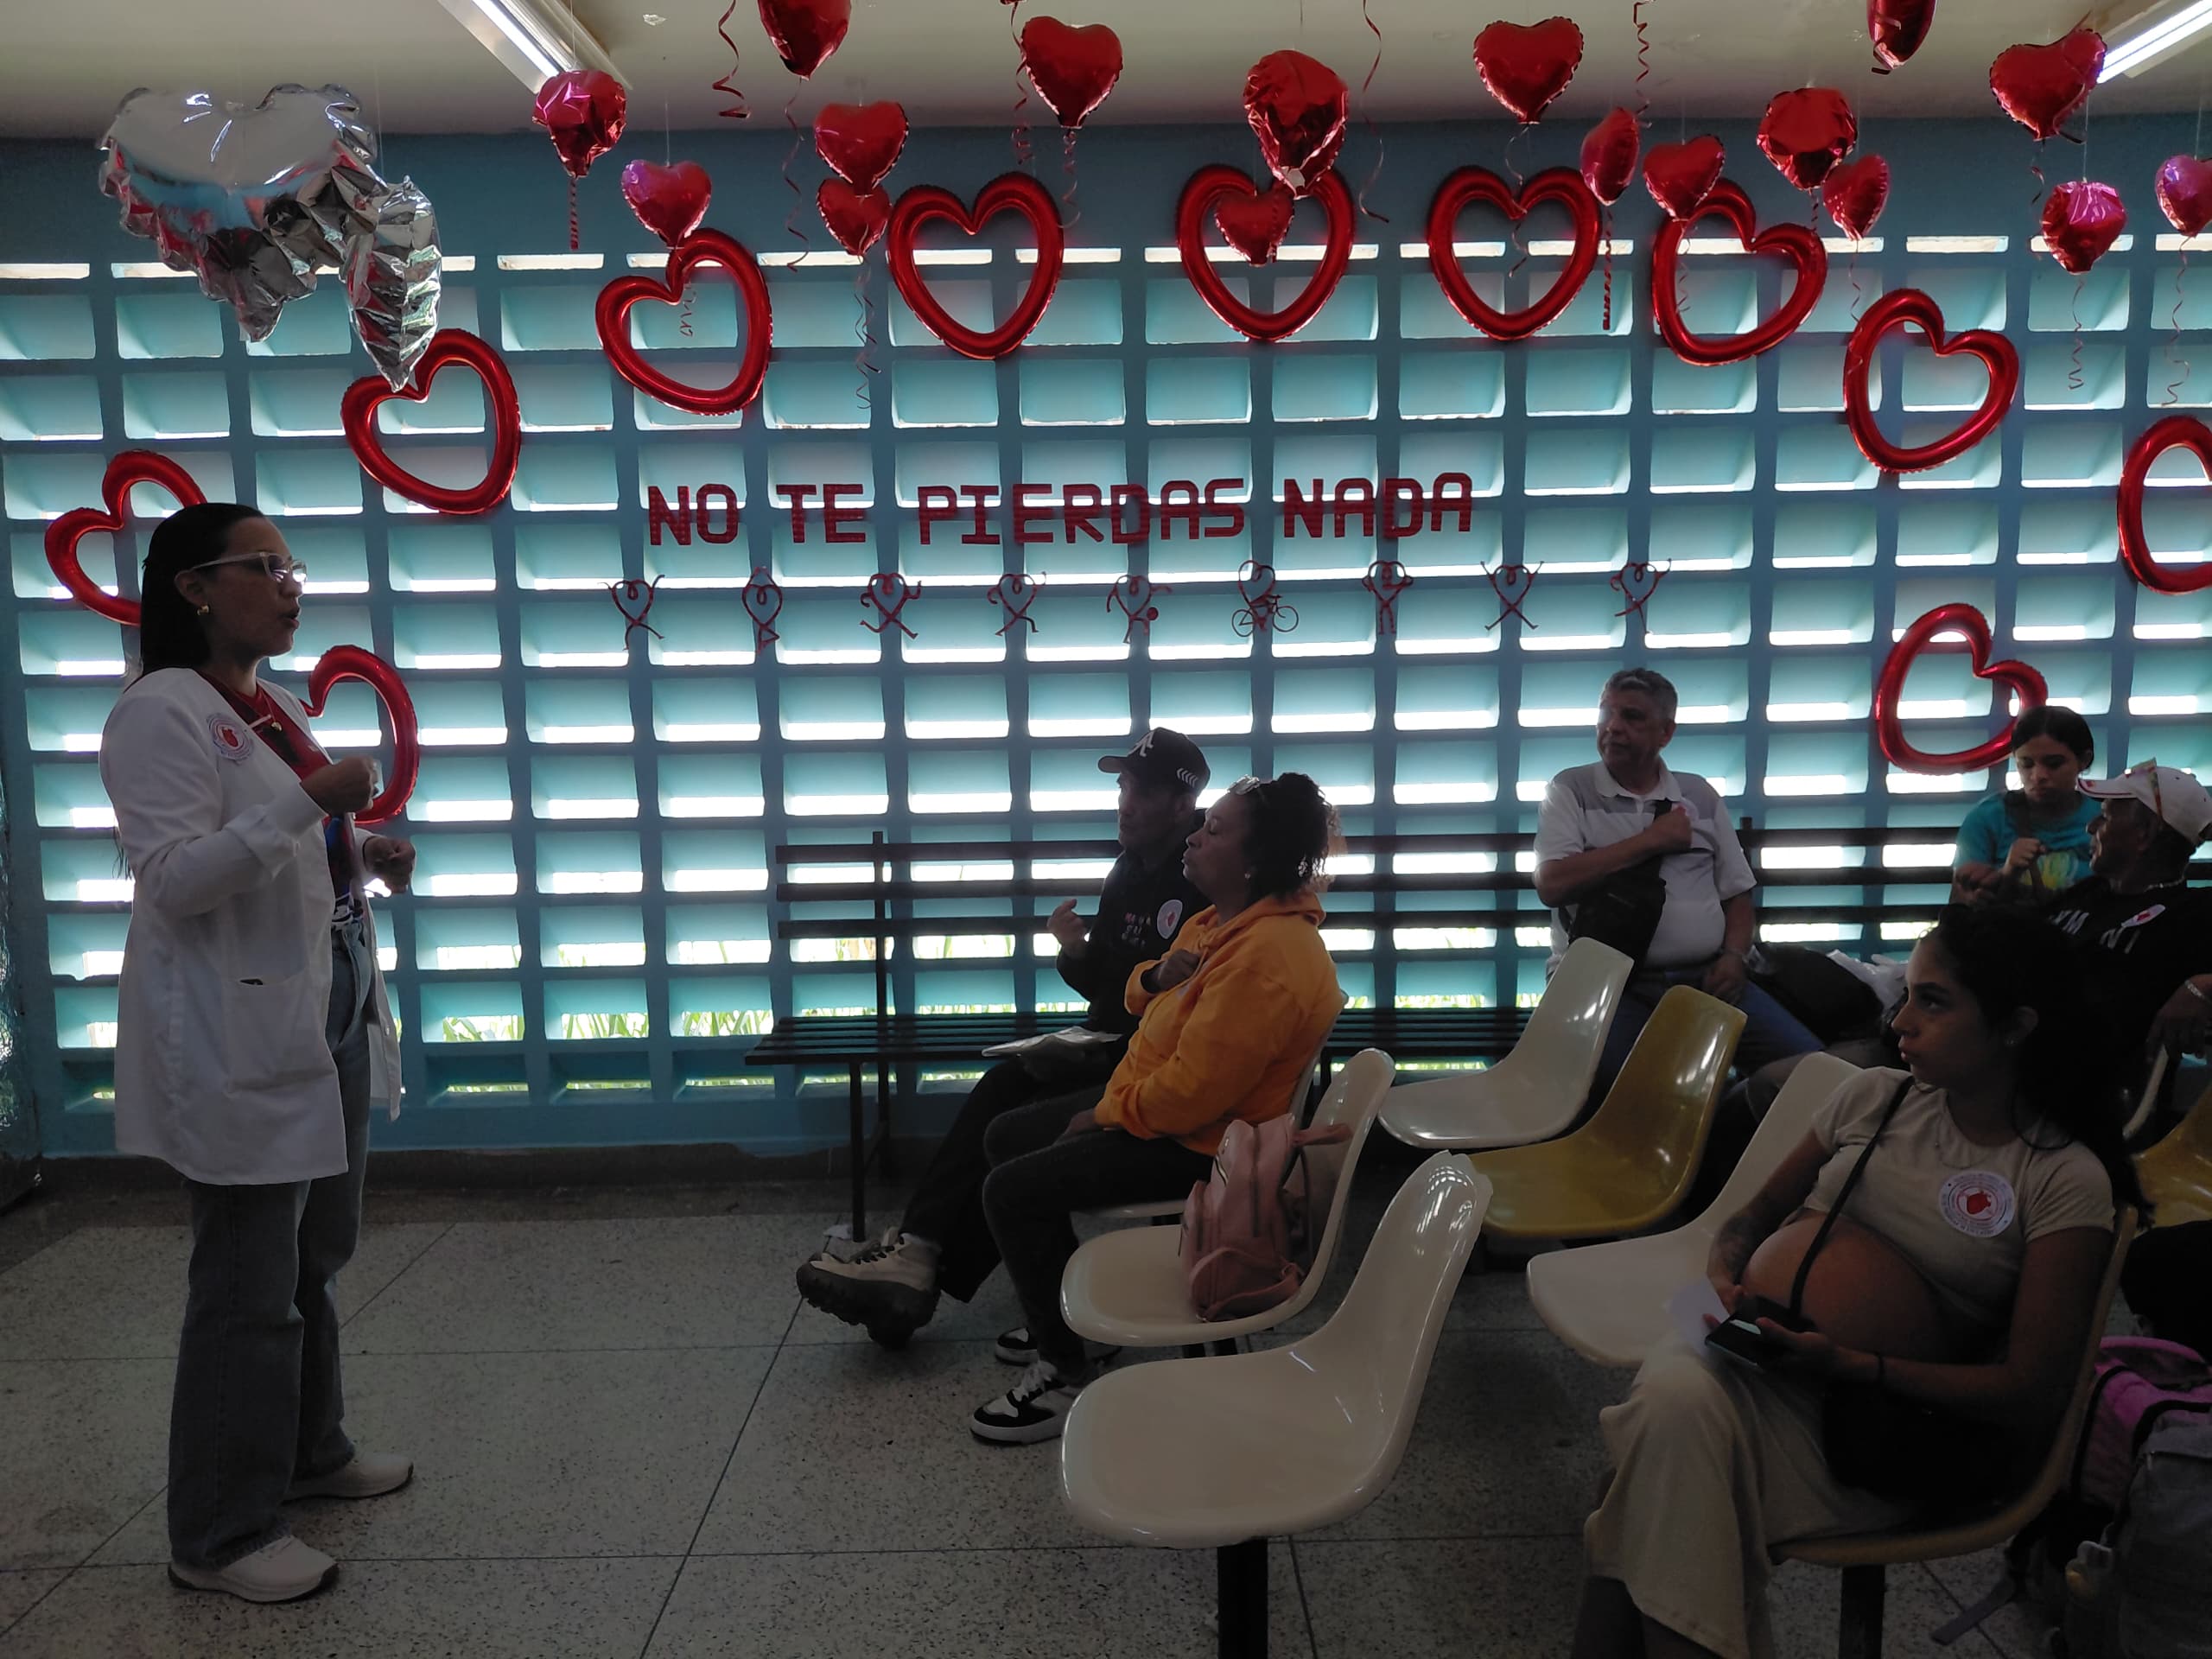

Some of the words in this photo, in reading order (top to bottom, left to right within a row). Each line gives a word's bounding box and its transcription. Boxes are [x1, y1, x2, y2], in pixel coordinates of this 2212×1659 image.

[647, 483, 739, 546] NO
[776, 483, 867, 543] TE
[917, 478, 1245, 545] PIERDAS
[1283, 473, 1473, 538] NADA
